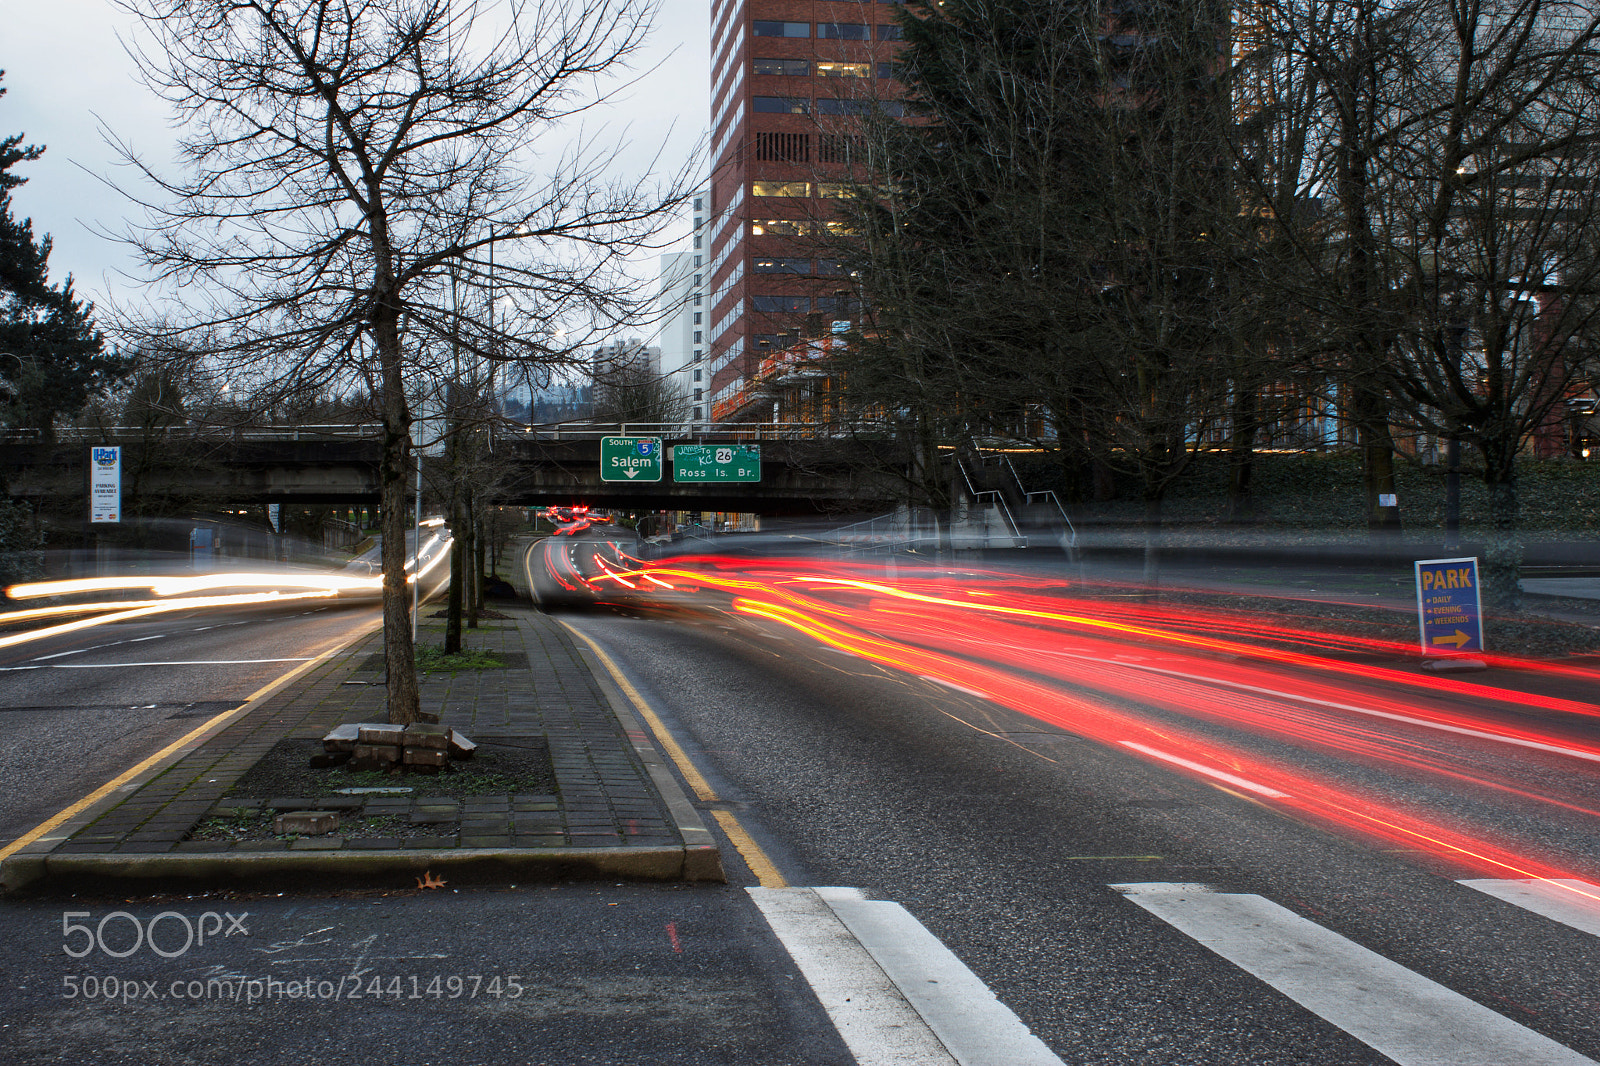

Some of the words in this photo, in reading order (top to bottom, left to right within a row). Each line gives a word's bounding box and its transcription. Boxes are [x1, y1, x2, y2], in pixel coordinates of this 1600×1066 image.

[642, 444, 649, 453] 5
[717, 451, 731, 461] 26
[611, 457, 652, 467] Salem
[679, 468, 706, 477] Ross
[715, 468, 728, 477] Is.
[738, 468, 755, 477] Br.
[1422, 568, 1472, 590] PARK
[1432, 595, 1452, 604] DAILY
[1433, 605, 1462, 614] EVENING
[1434, 615, 1469, 625] WEEKENDS
